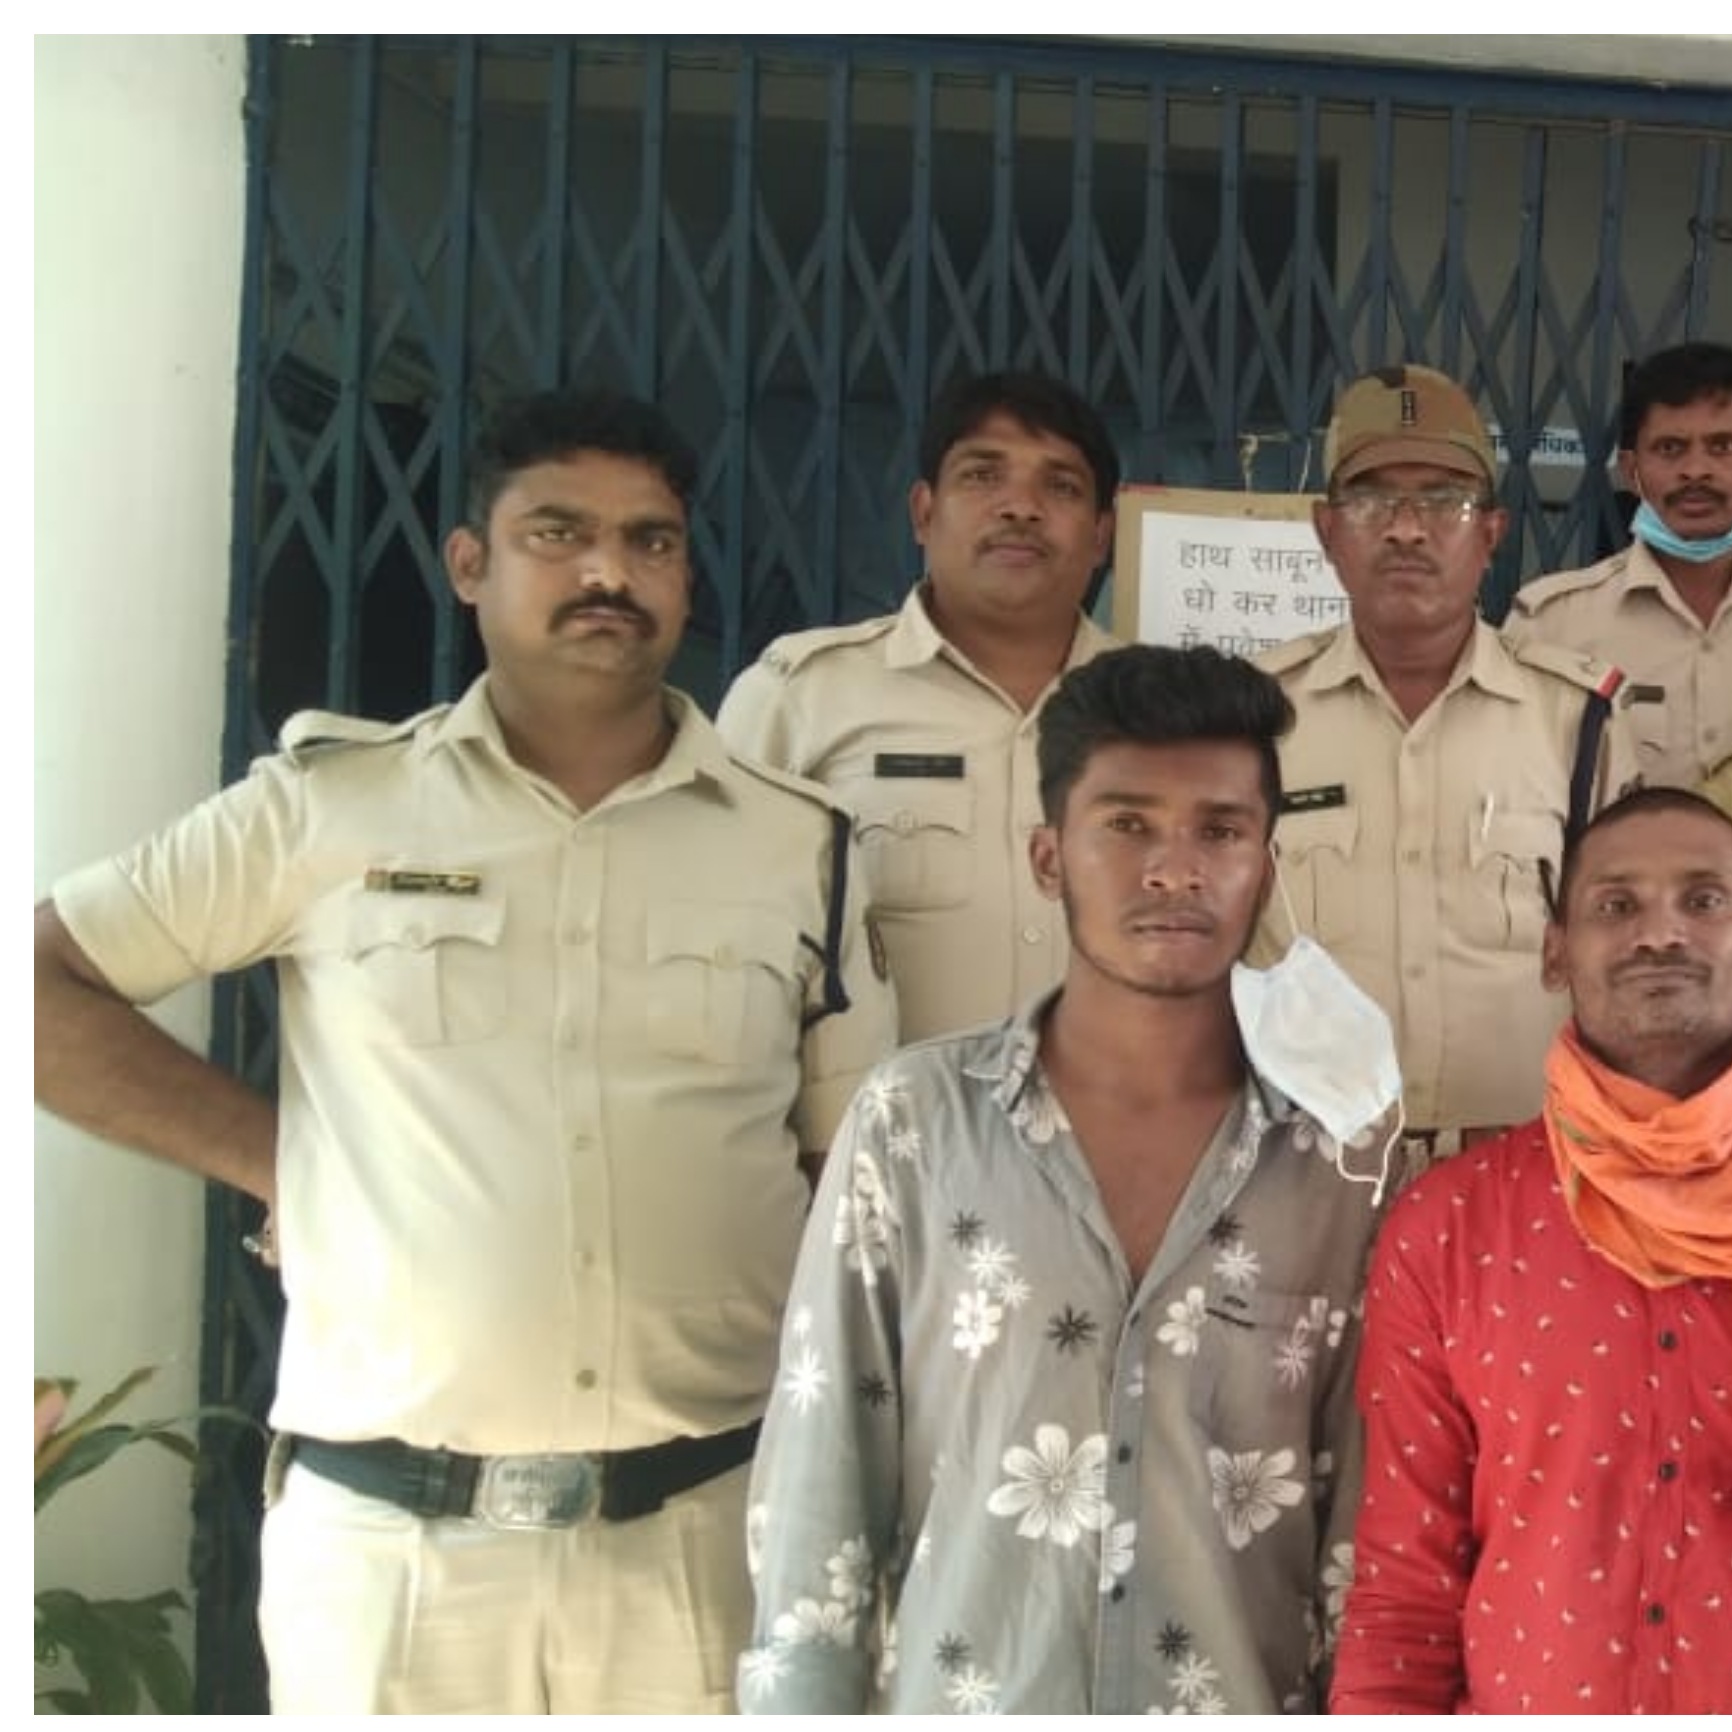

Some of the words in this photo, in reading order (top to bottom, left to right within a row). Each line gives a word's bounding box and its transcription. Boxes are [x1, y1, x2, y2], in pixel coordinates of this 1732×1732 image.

[1179, 541, 1234, 569] हाथ
[1183, 579, 1216, 612] धो
[1233, 591, 1277, 616] कर
